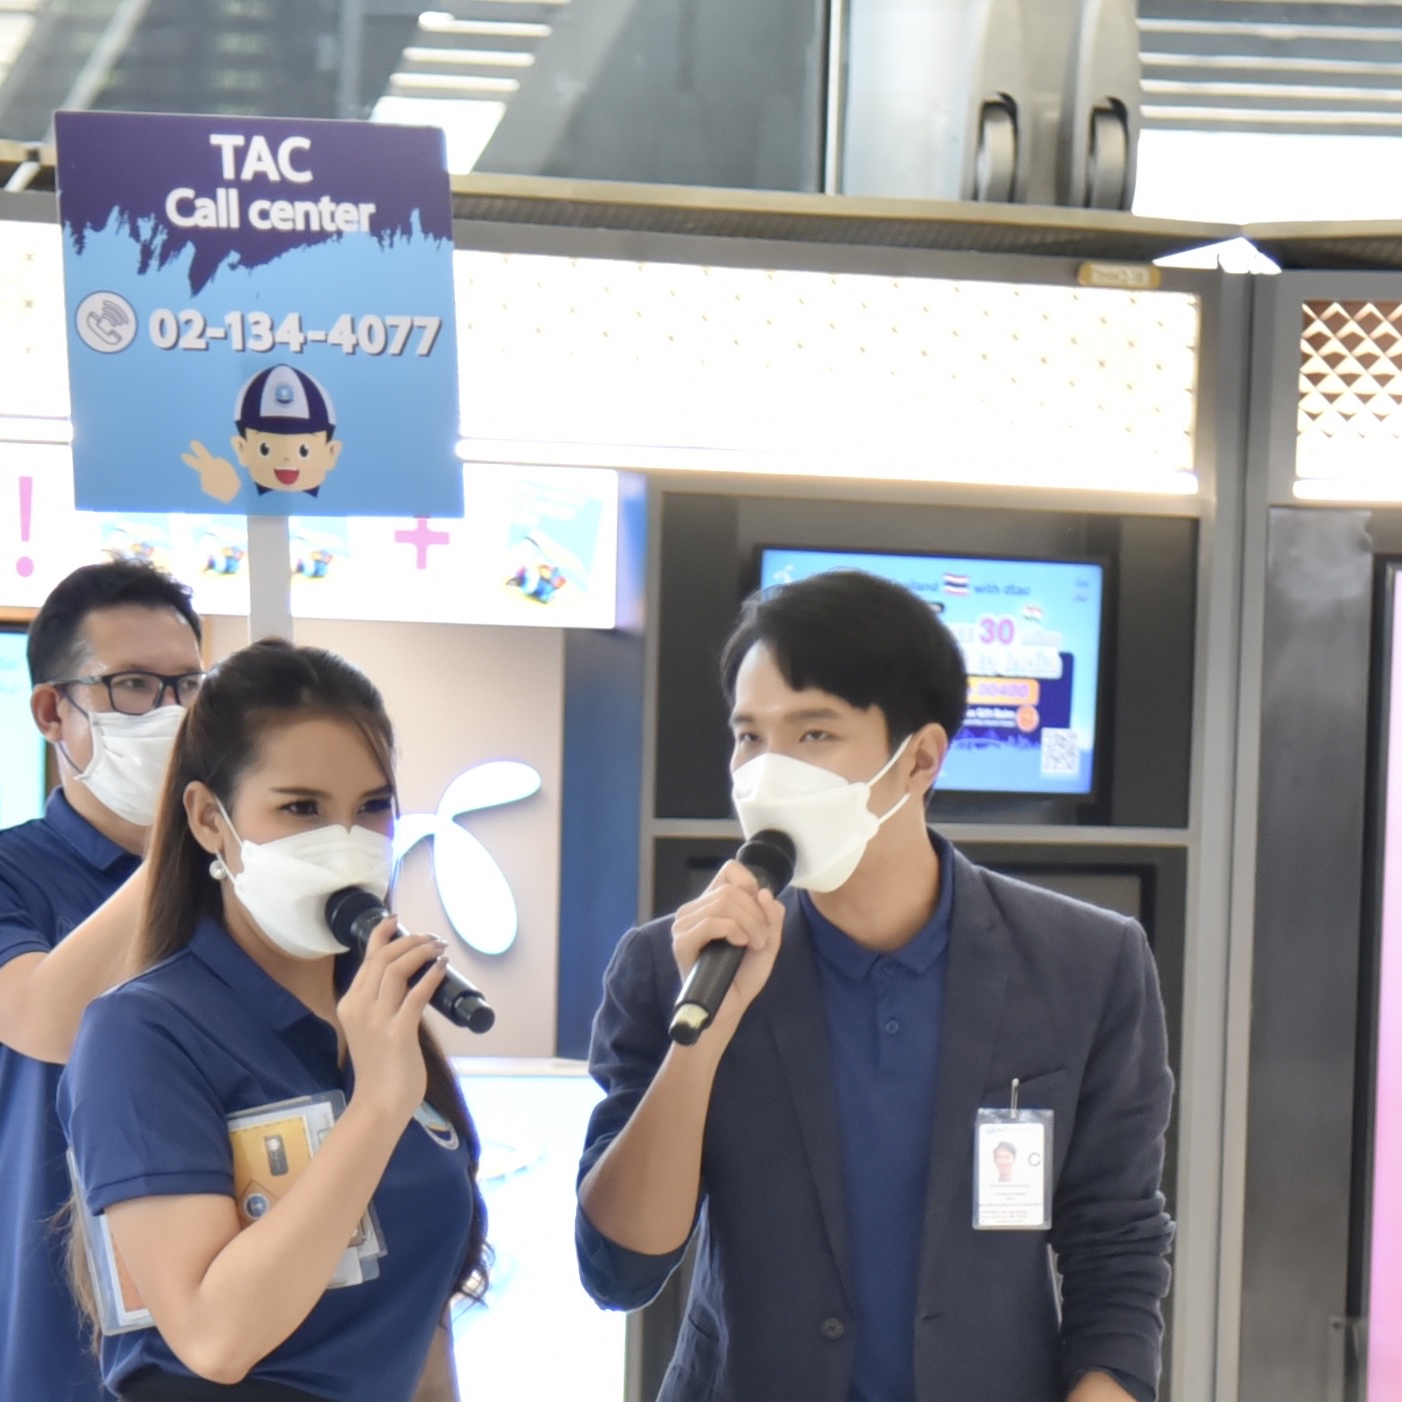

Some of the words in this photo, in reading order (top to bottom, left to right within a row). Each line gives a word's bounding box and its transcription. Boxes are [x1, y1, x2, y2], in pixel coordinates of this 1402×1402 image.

[210, 134, 313, 183] TAC
[165, 188, 240, 229] Call
[248, 194, 376, 234] center
[149, 309, 441, 356] 02-134-4077
[979, 616, 1015, 646] 30
